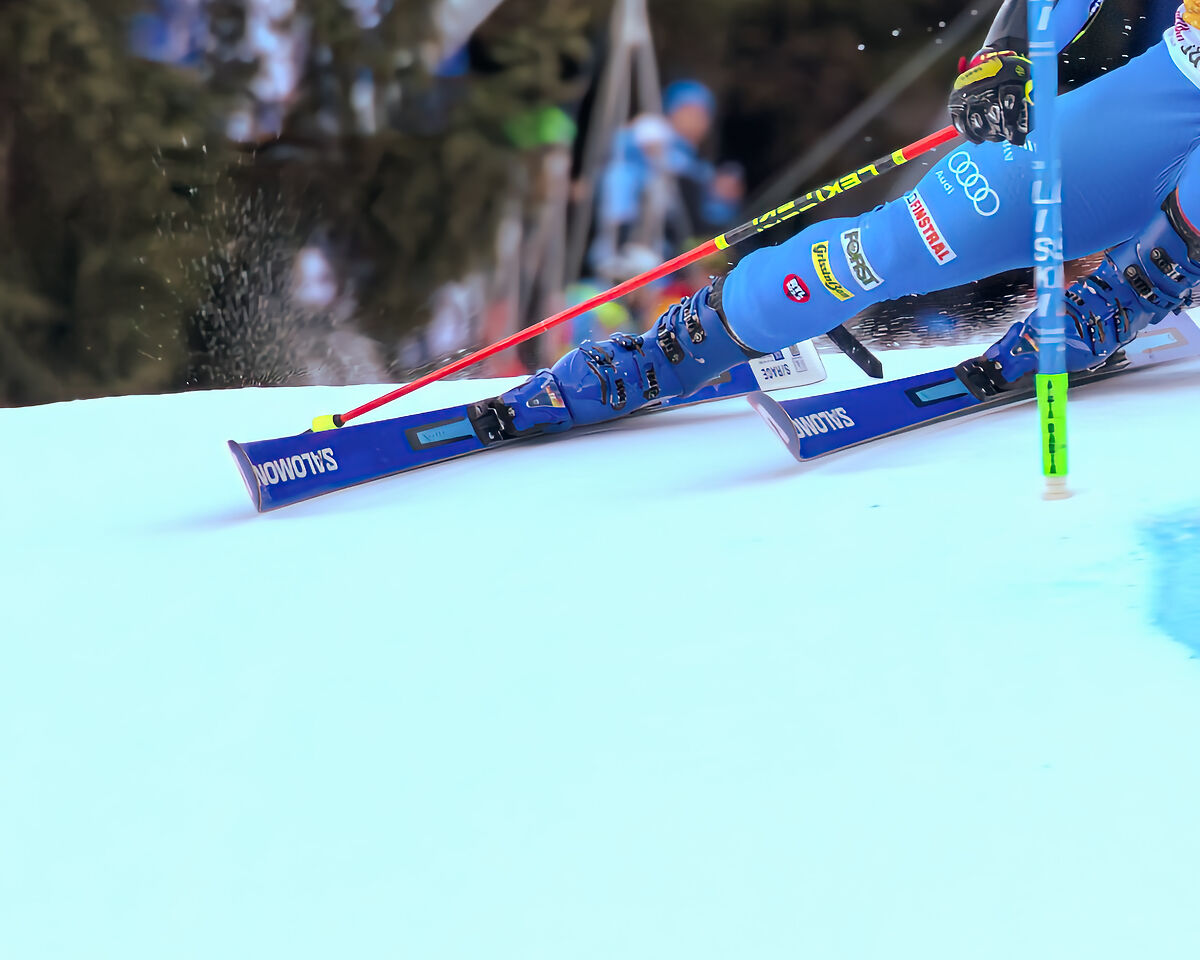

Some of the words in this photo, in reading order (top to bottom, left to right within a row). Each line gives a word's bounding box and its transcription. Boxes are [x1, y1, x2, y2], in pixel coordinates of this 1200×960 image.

[935, 170, 955, 195] Audi
[909, 199, 950, 261] FINSTRAL
[844, 230, 880, 286] FORST
[252, 447, 338, 486] SALOMON
